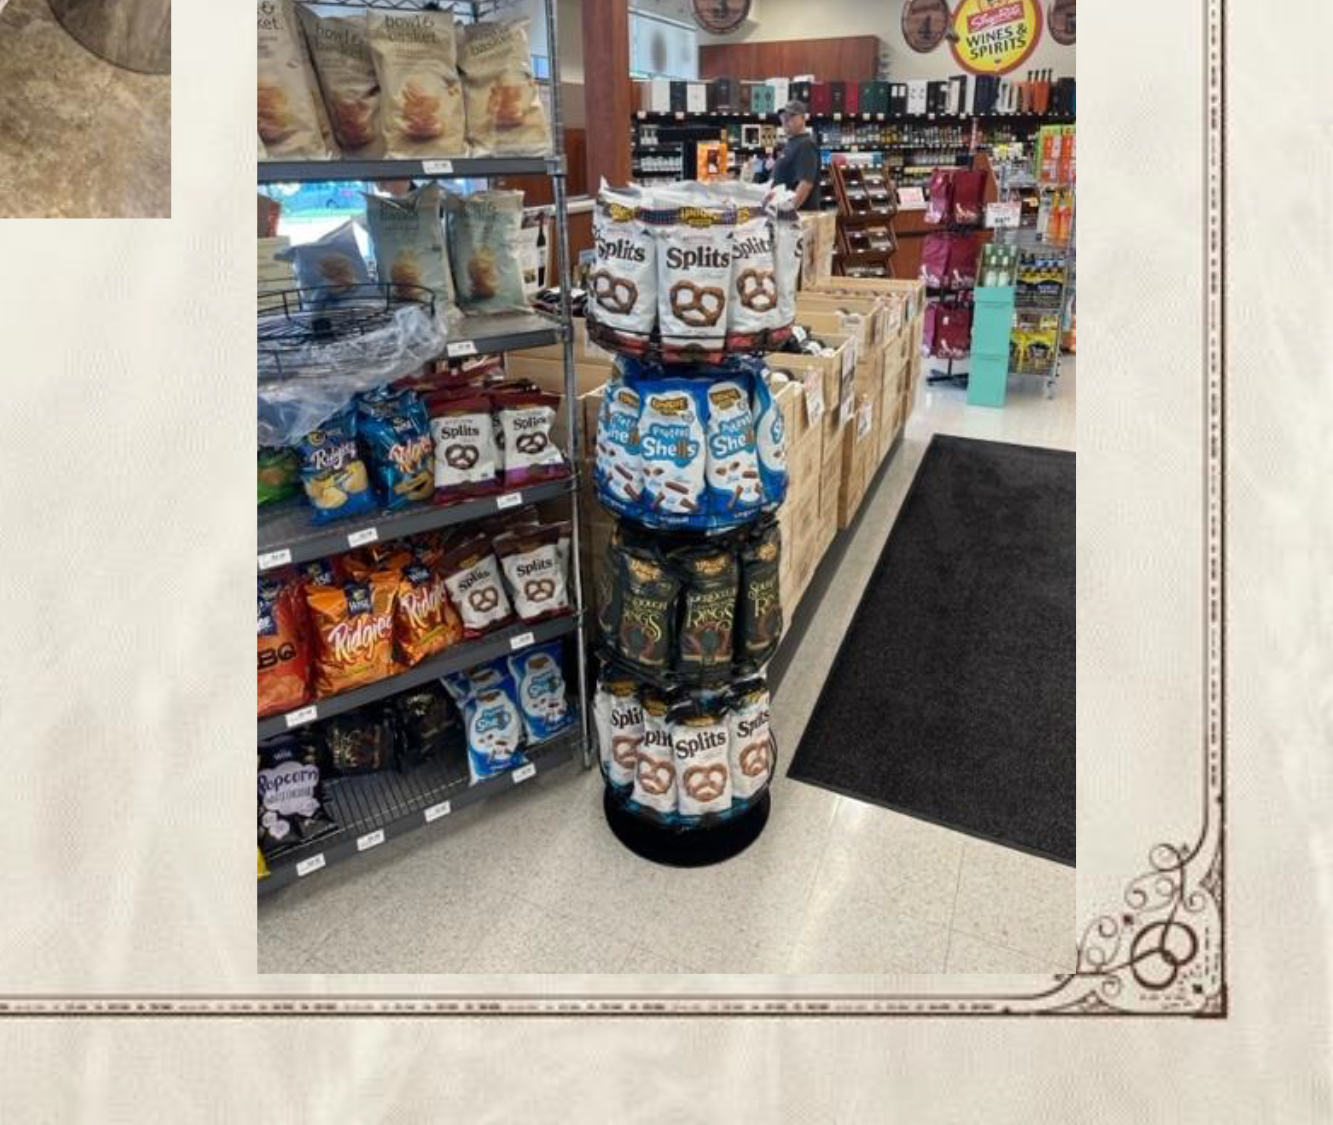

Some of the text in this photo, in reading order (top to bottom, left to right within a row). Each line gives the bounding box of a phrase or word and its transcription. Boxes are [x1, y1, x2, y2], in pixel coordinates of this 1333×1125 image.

[966, 22, 1027, 48] WINES &
[969, 36, 1027, 60] SPIRITS
[598, 237, 646, 263] Splits
[666, 246, 731, 271] Splits
[440, 426, 480, 445] Splits
[514, 555, 554, 577] Splits
[675, 730, 727, 760] Splits
[257, 770, 319, 795] Popcorn
